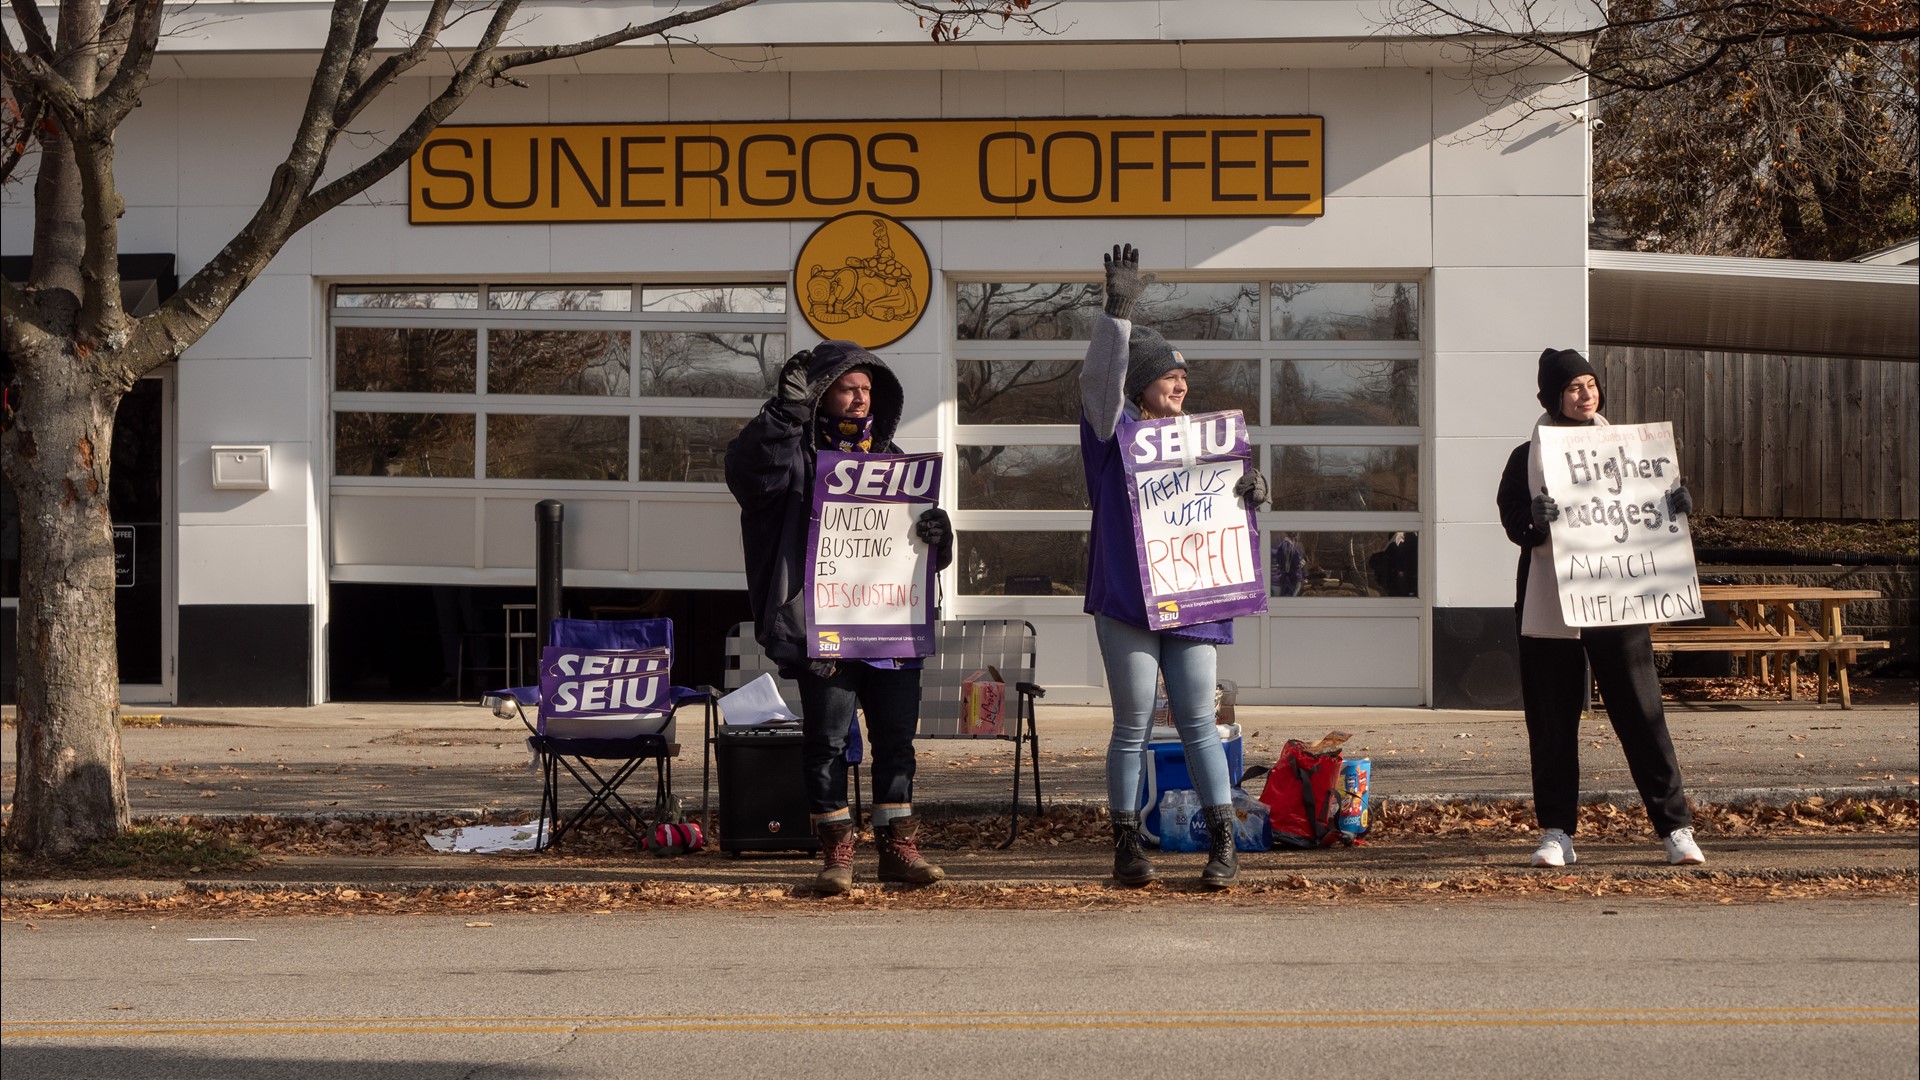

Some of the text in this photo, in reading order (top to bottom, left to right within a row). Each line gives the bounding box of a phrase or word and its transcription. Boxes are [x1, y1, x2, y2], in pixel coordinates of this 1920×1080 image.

[421, 129, 1312, 210] SUNERGOS COFFEE
[1135, 417, 1236, 464] SEIU
[1636, 424, 1673, 442] Union
[827, 459, 935, 497] SEIU
[1564, 445, 1671, 496] Higher
[1139, 468, 1232, 509] TREAT US
[824, 505, 890, 532] UNION
[1163, 496, 1213, 527] WITH
[820, 536, 893, 559] BUSTING
[1147, 525, 1246, 596] RESPECT
[816, 560, 837, 577] IS
[1569, 551, 1658, 580] MATCH
[816, 582, 920, 609] DISGUSTING
[1569, 576, 1702, 623] INFLATION!
[1159, 612, 1179, 622] SEIU
[819, 643, 840, 652] SEIU
[555, 676, 659, 712] SEIU
